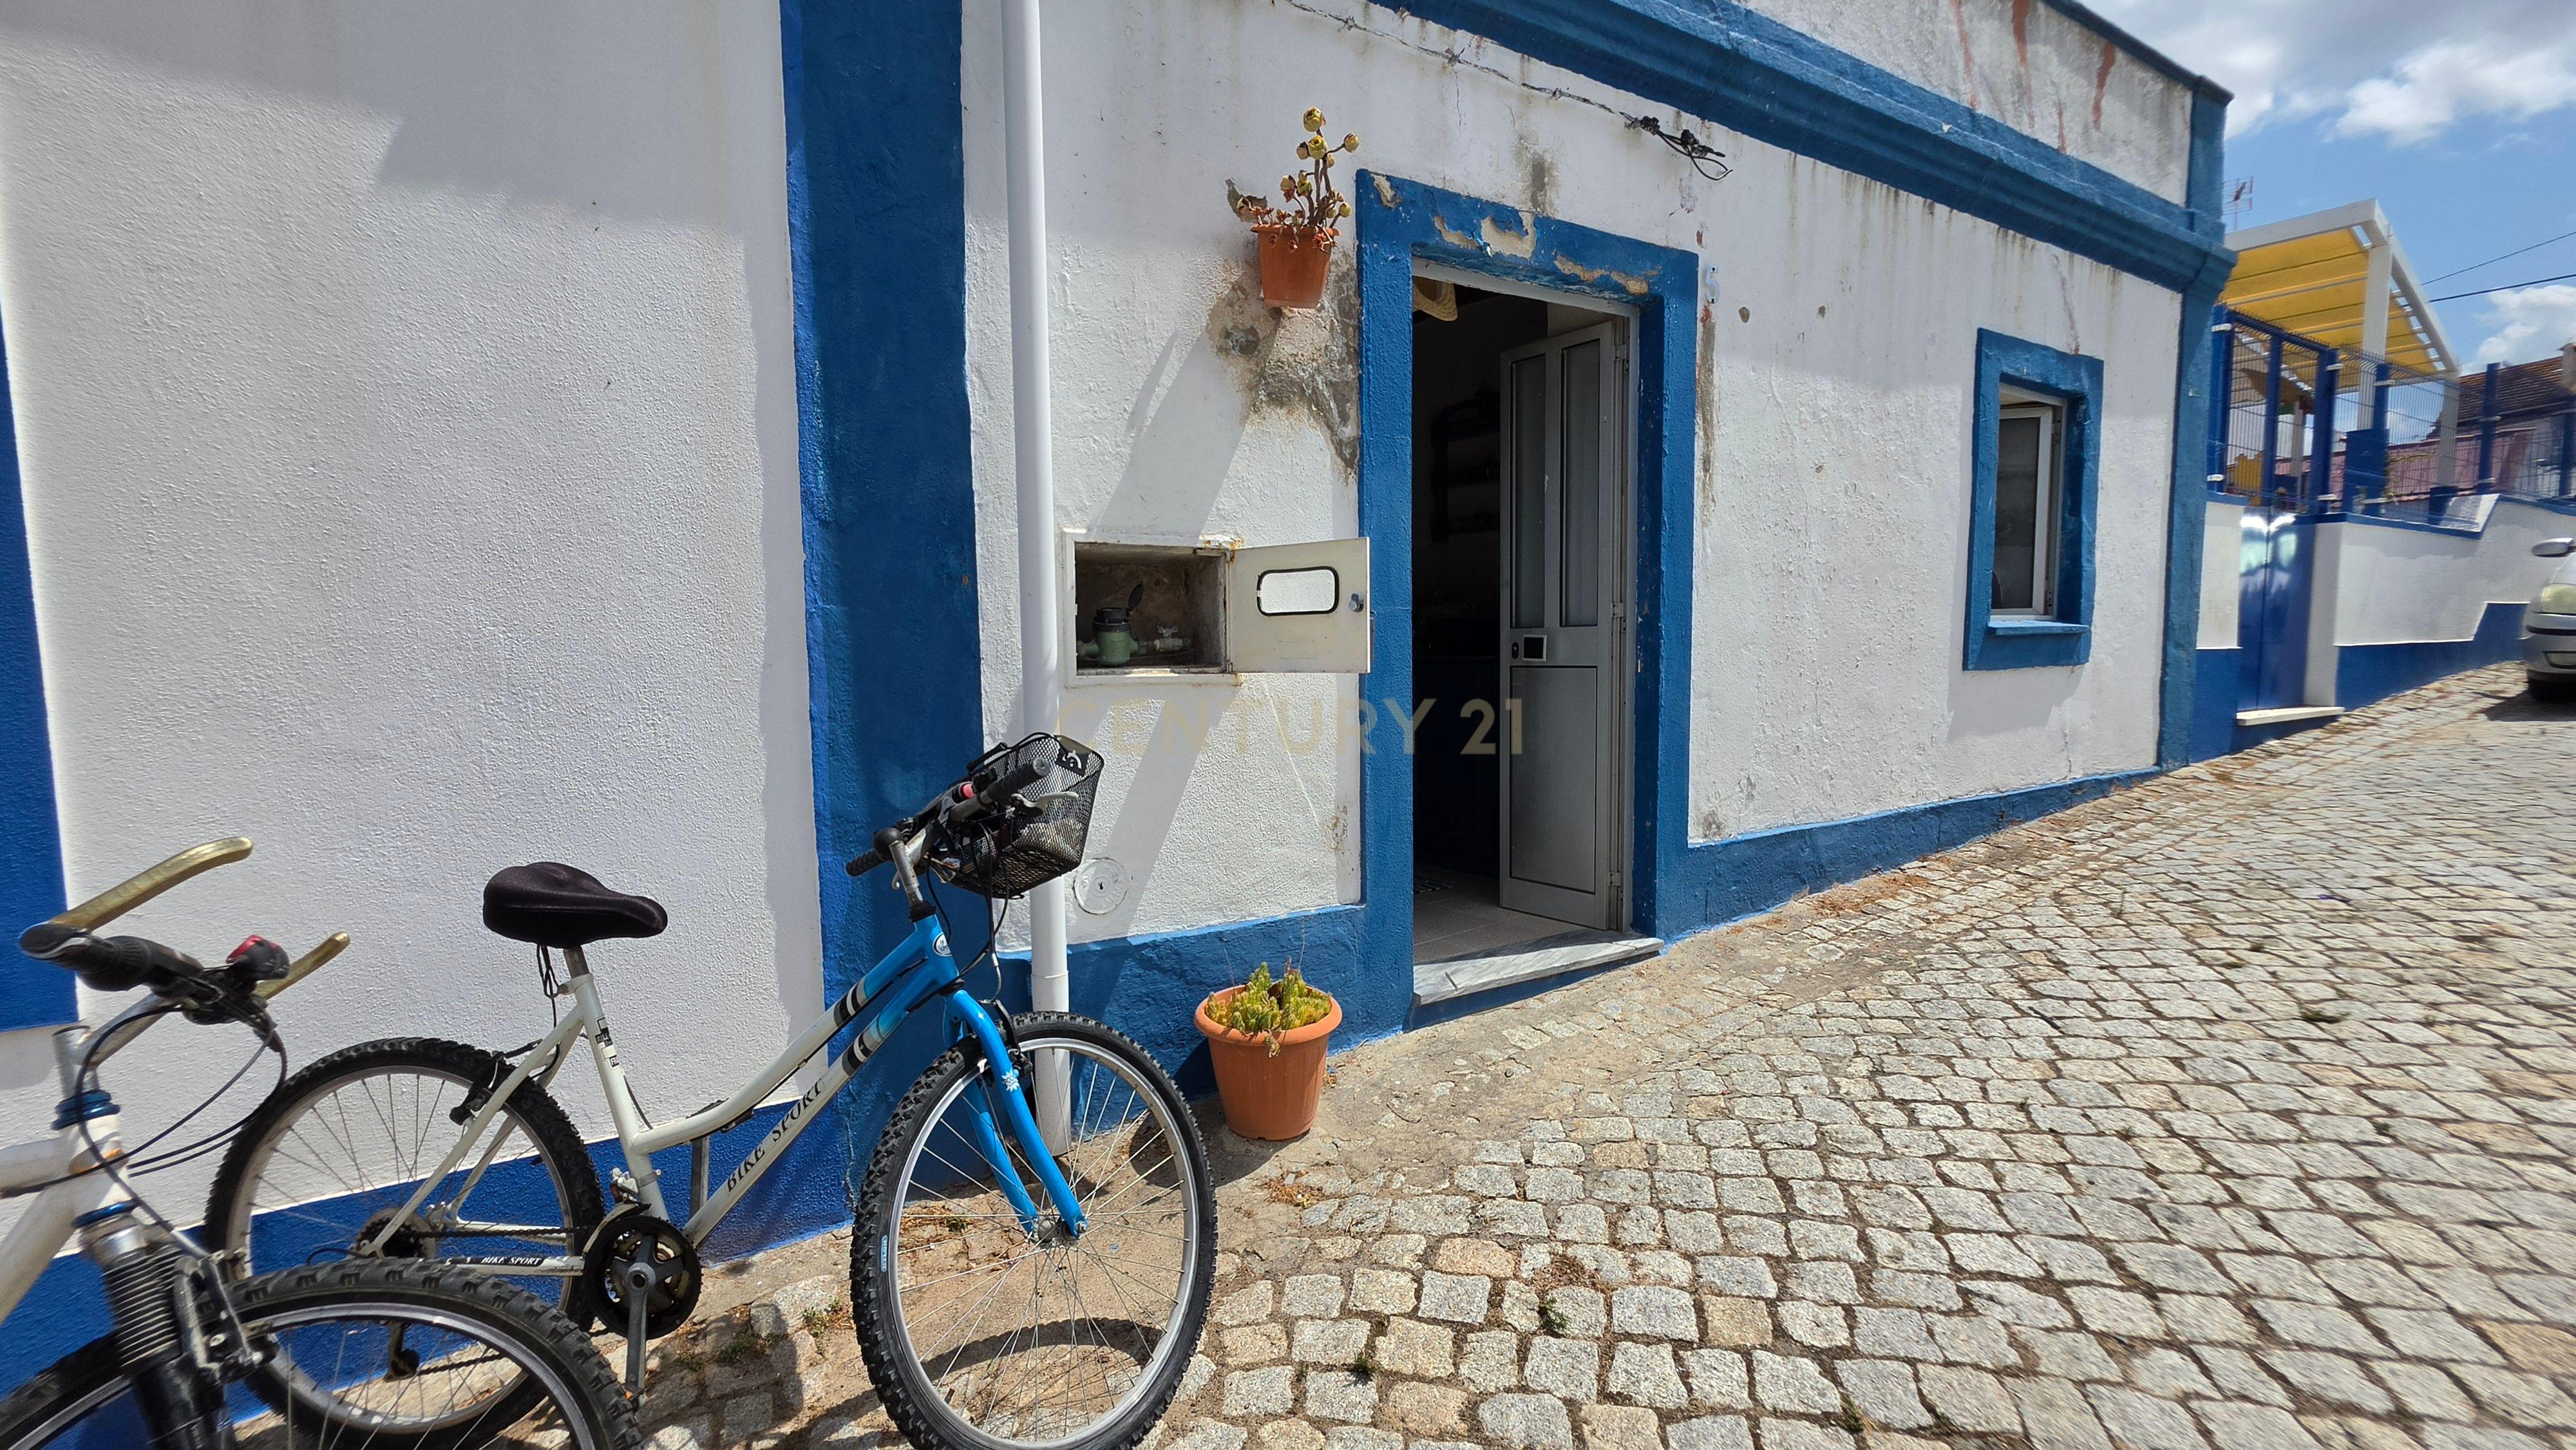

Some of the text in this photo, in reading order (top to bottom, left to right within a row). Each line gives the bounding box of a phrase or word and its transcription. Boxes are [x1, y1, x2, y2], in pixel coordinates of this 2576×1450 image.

[1705, 264, 1719, 303] 5
[726, 1078, 824, 1192] BIKE SPORT
[508, 1257, 542, 1265] SPORT
